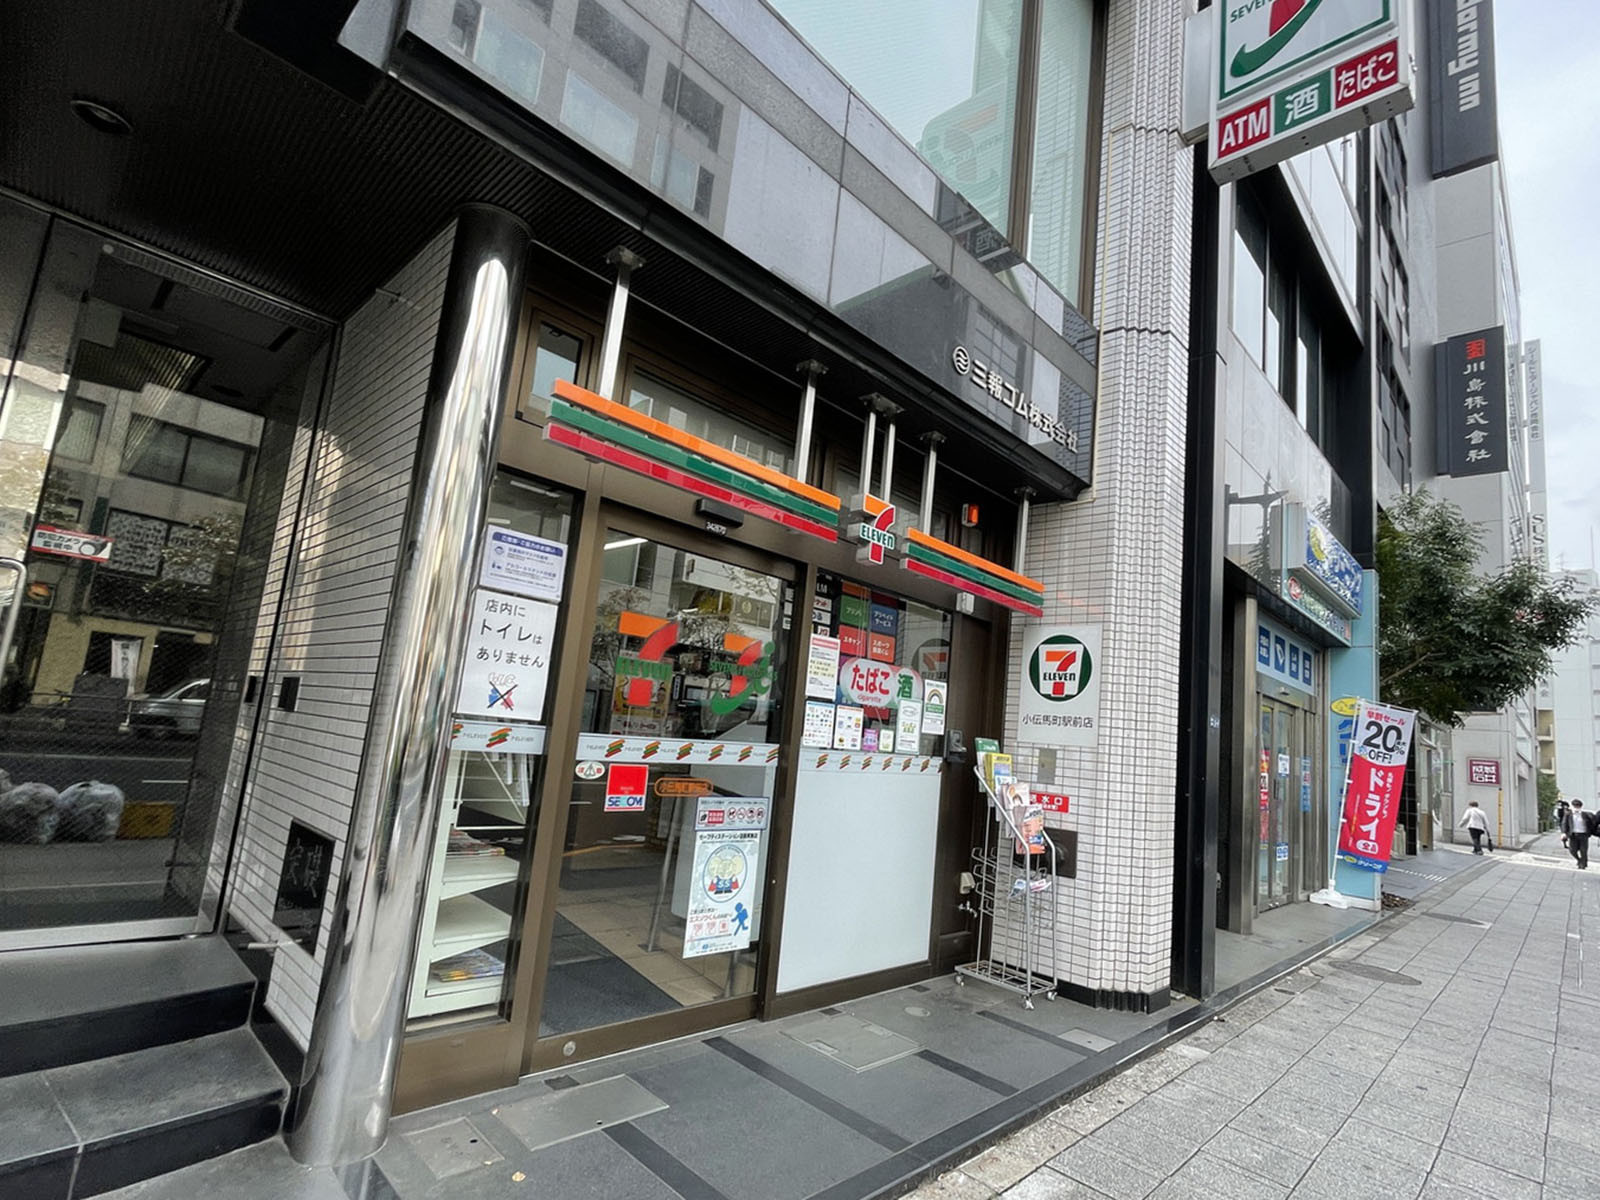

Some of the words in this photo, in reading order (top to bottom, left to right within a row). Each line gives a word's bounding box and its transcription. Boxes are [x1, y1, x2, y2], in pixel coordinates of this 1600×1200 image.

[1338, 52, 1396, 101] たばこ
[1285, 83, 1320, 125] 酒
[1220, 107, 1268, 151] ATM
[971, 359, 1078, 453] 三報ゴム株式会社
[485, 599, 526, 617] 店内に
[480, 618, 543, 645] トイレは
[476, 646, 544, 668] ありません
[851, 664, 890, 695] たばこ
[896, 673, 913, 699] 酒
[1022, 713, 1094, 728] 小伝馬町駅前店
[1368, 749, 1392, 764] OFF!
[1359, 767, 1385, 840] ドライ
